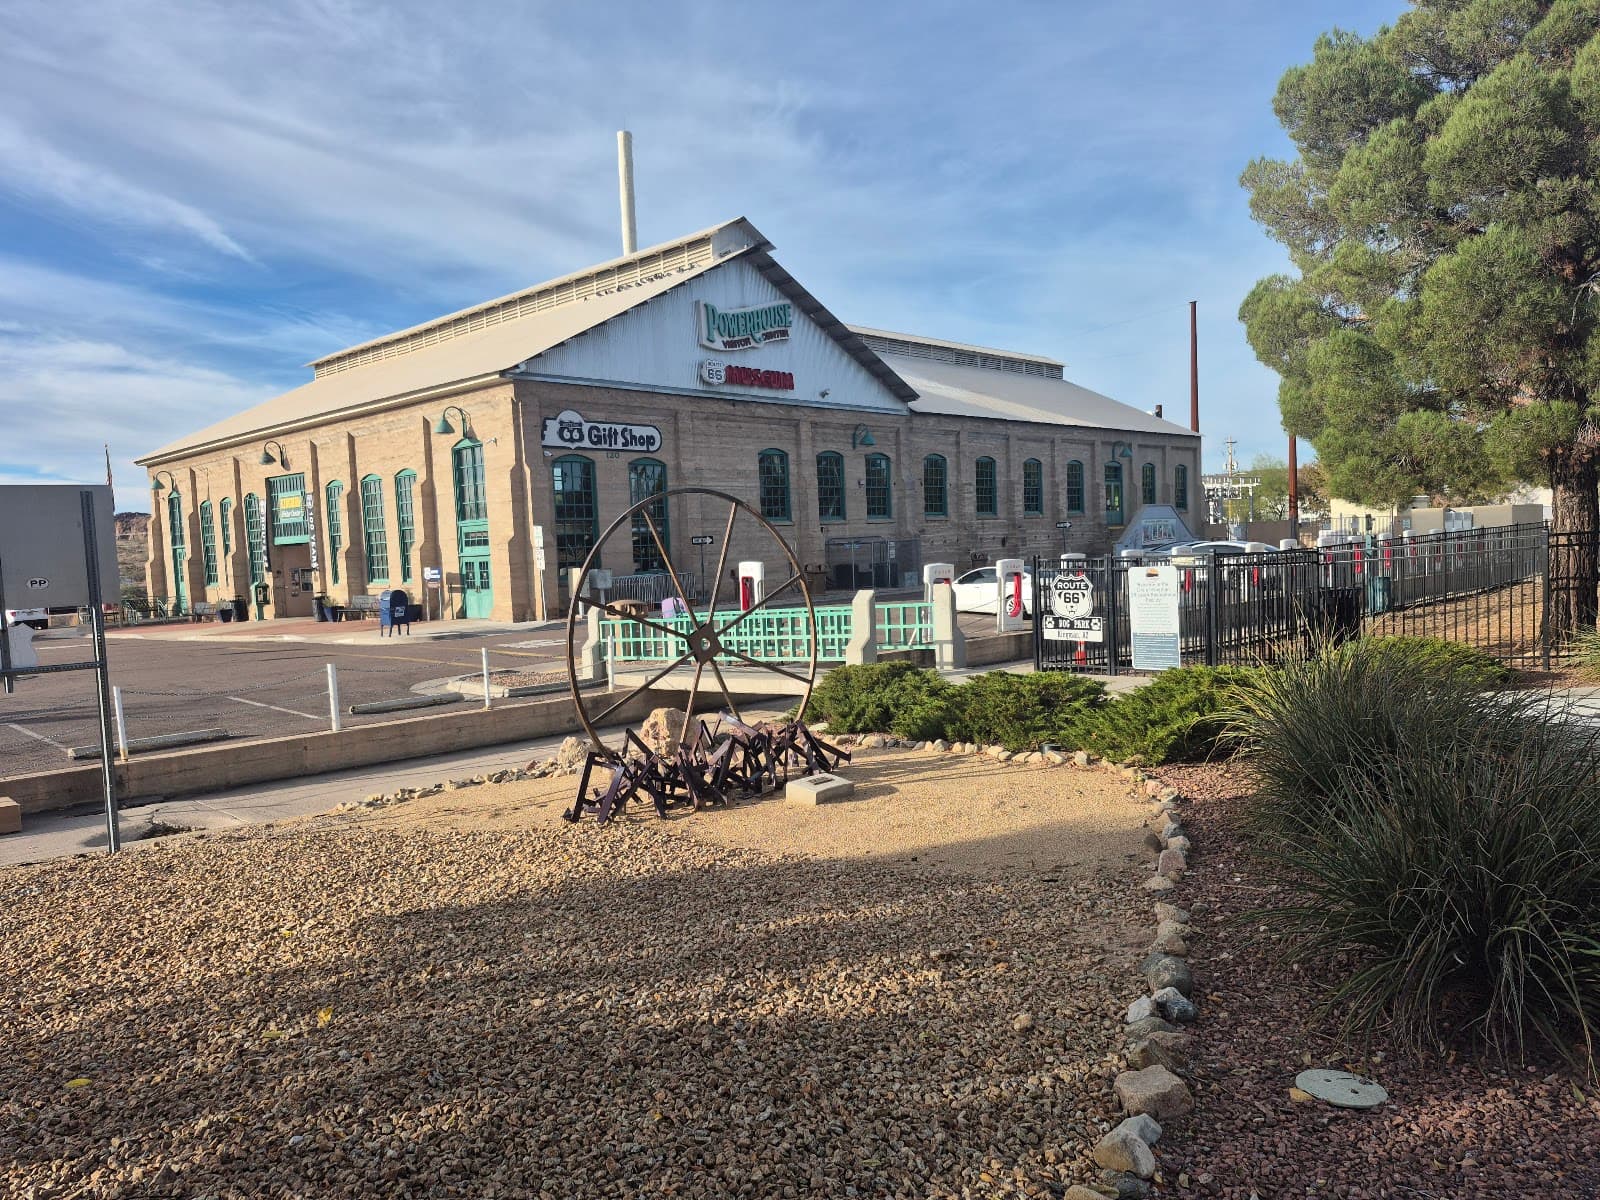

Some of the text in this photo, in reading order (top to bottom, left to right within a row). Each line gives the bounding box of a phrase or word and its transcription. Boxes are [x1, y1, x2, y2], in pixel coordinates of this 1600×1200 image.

[704, 303, 792, 343] POWERHOUSE
[707, 365, 794, 390] 66 MUSEUM
[562, 425, 656, 450] 66 Gift Shop
[1057, 581, 1087, 589] ROUTE
[1064, 592, 1080, 604] 66
[1073, 619, 1090, 629] PARK
